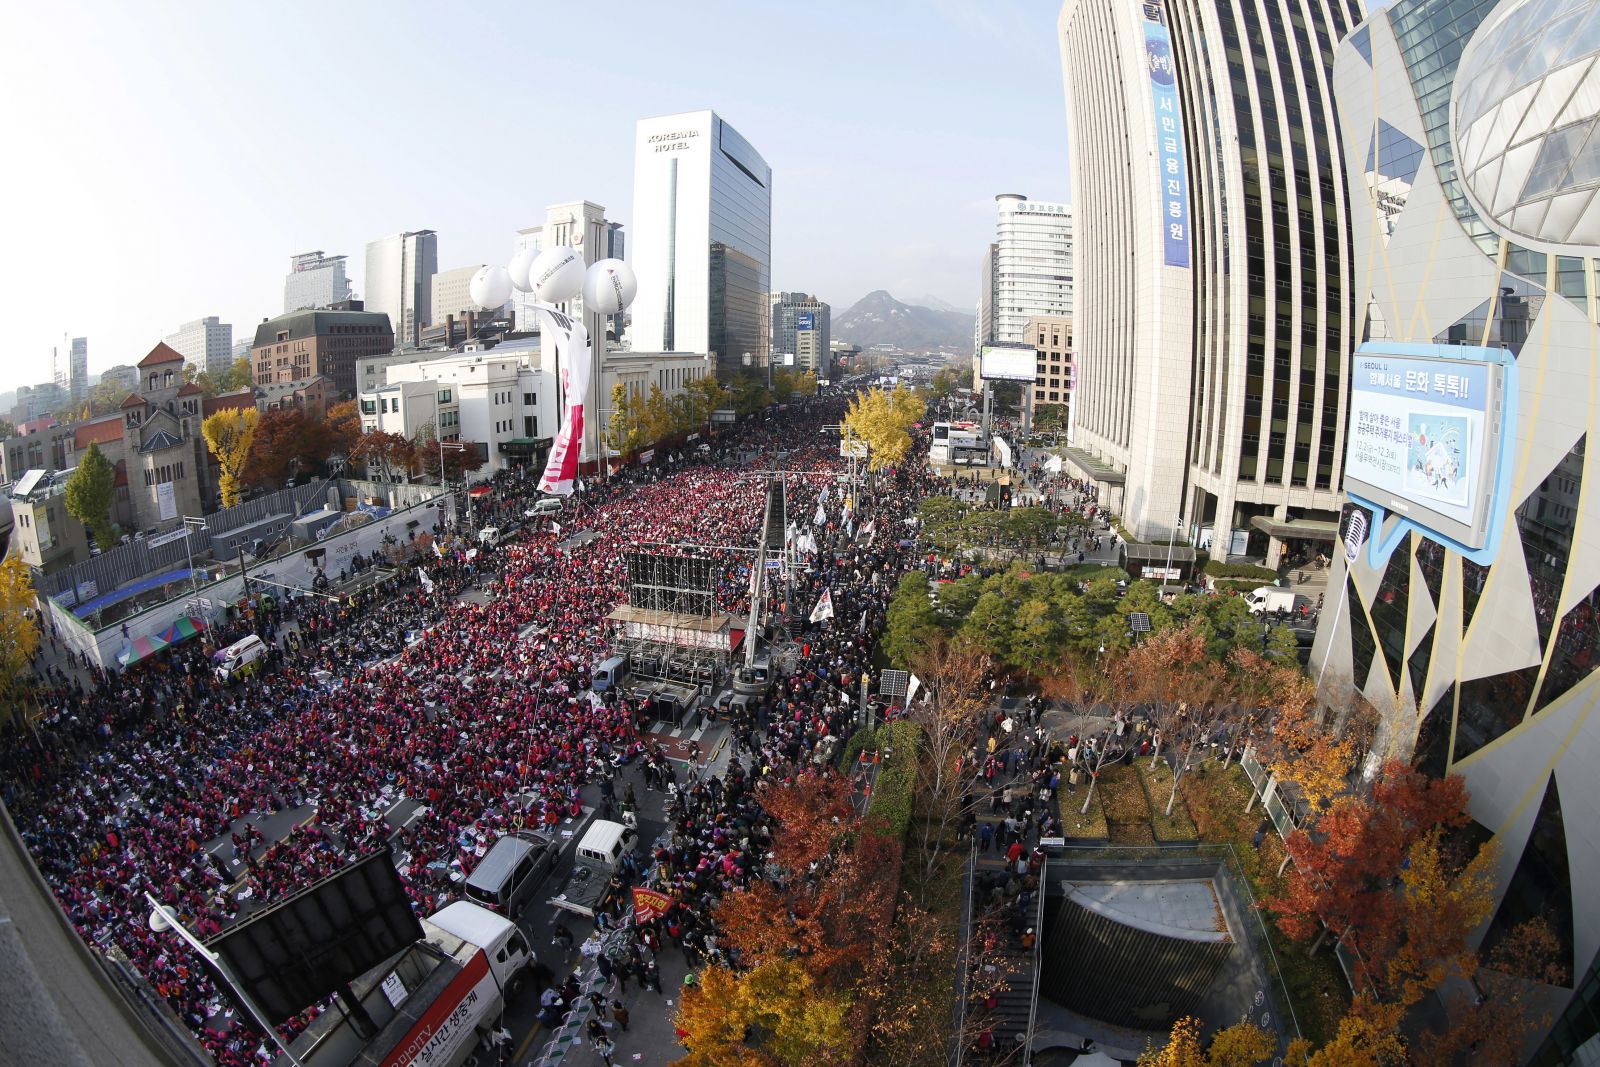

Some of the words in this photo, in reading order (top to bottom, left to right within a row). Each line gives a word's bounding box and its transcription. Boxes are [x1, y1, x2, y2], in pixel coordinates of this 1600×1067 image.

[1152, 54, 1168, 71] 출범
[648, 130, 699, 143] KOREANA
[655, 142, 690, 152] HOTEL
[1160, 97, 1183, 240] 서민금융진흥원
[1364, 362, 1382, 370] SEOUL
[1406, 370, 1429, 393] 문화
[1434, 373, 1469, 399] 톡톡!!
[421, 1024, 450, 1063] 실시간
[449, 990, 478, 1027] 생중계
